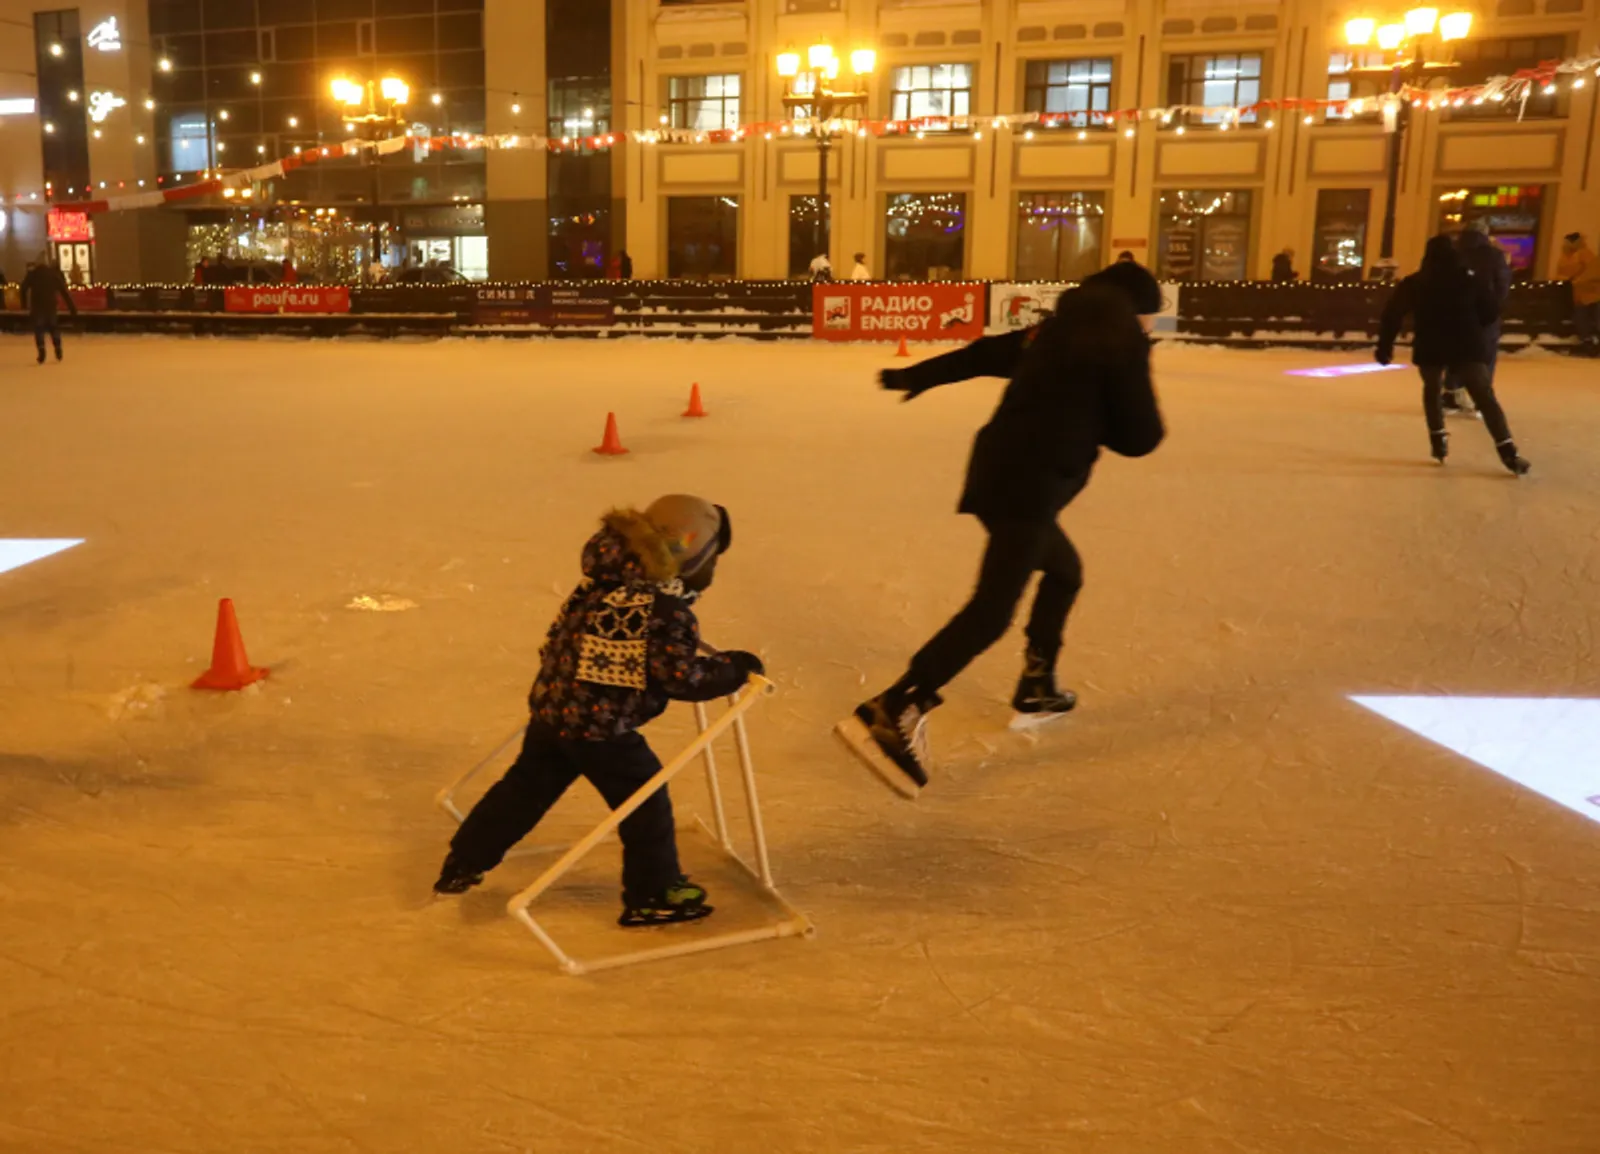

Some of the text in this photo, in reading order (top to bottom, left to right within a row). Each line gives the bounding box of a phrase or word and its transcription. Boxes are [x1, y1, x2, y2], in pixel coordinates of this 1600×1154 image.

[476, 289, 535, 300] СИМВЛ
[860, 296, 932, 312] РАДИО
[860, 315, 931, 330] ENERGY
